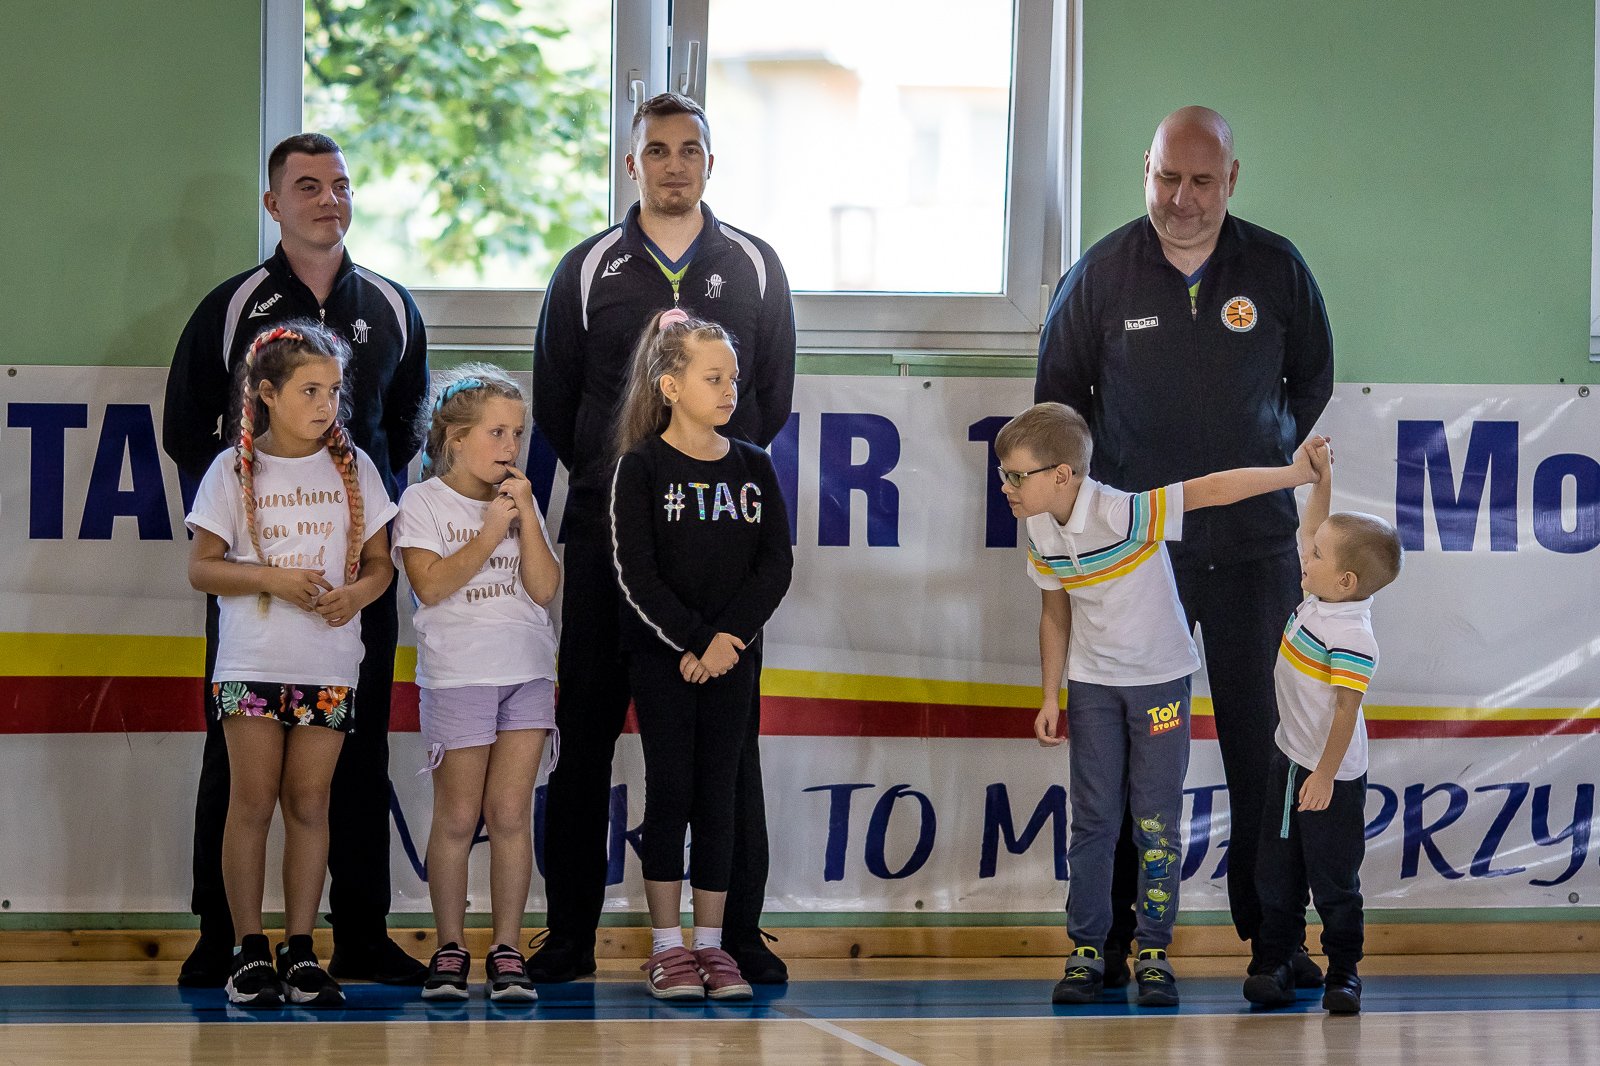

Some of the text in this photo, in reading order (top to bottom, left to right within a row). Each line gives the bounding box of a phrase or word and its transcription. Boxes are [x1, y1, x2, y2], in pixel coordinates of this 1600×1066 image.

[7, 402, 194, 541] TA
[254, 487, 344, 510] unshine
[663, 482, 762, 523] #TAG
[263, 521, 335, 541] on my
[489, 556, 520, 575] my
[466, 576, 516, 603] mind
[1147, 701, 1180, 724] TOY
[1153, 719, 1180, 732] STORY
[802, 783, 936, 882] TO
